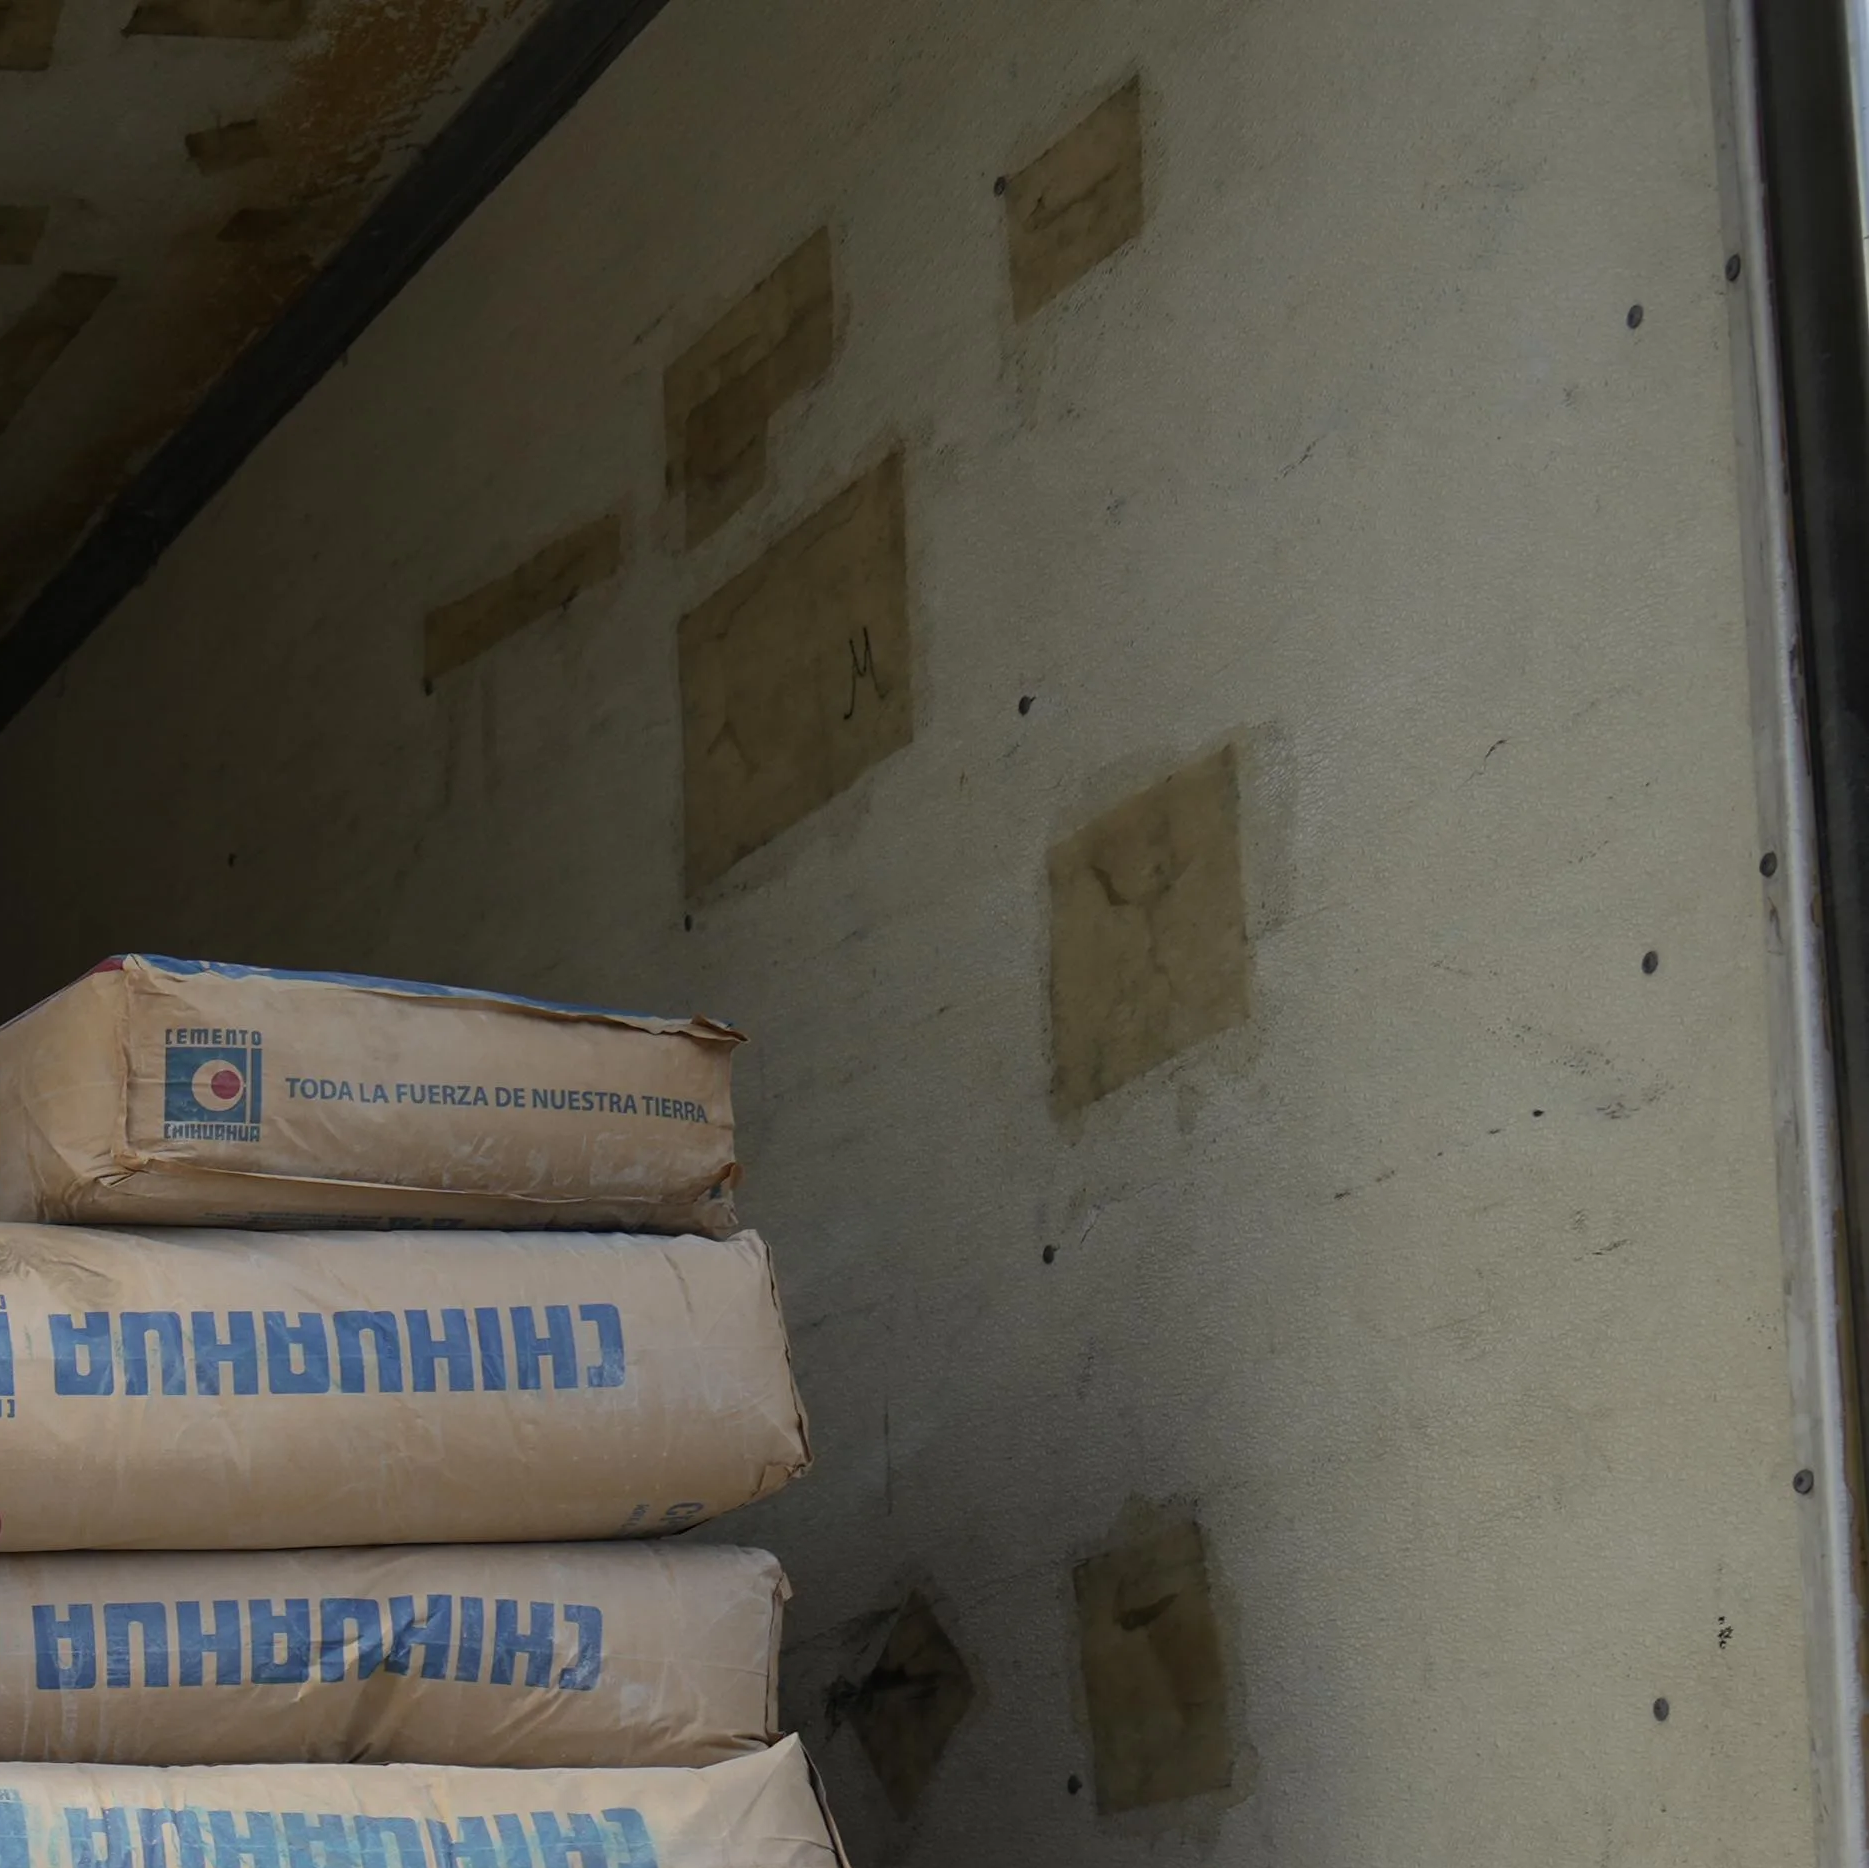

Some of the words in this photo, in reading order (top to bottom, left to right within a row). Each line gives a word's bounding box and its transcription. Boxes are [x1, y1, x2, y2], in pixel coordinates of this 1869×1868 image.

[164, 1027, 263, 1046] CEMENTO
[284, 1076, 354, 1101] TODA
[360, 1081, 389, 1103] LA
[395, 1083, 489, 1107] FUERZA
[495, 1086, 526, 1109] DE
[531, 1087, 638, 1116] NUESTRA
[643, 1094, 708, 1124] TIERRA
[163, 1122, 261, 1142] CHIHUAHUA
[47, 1303, 626, 1396] CHIHUAHUA
[31, 1593, 604, 1692] CHIHUAHUA
